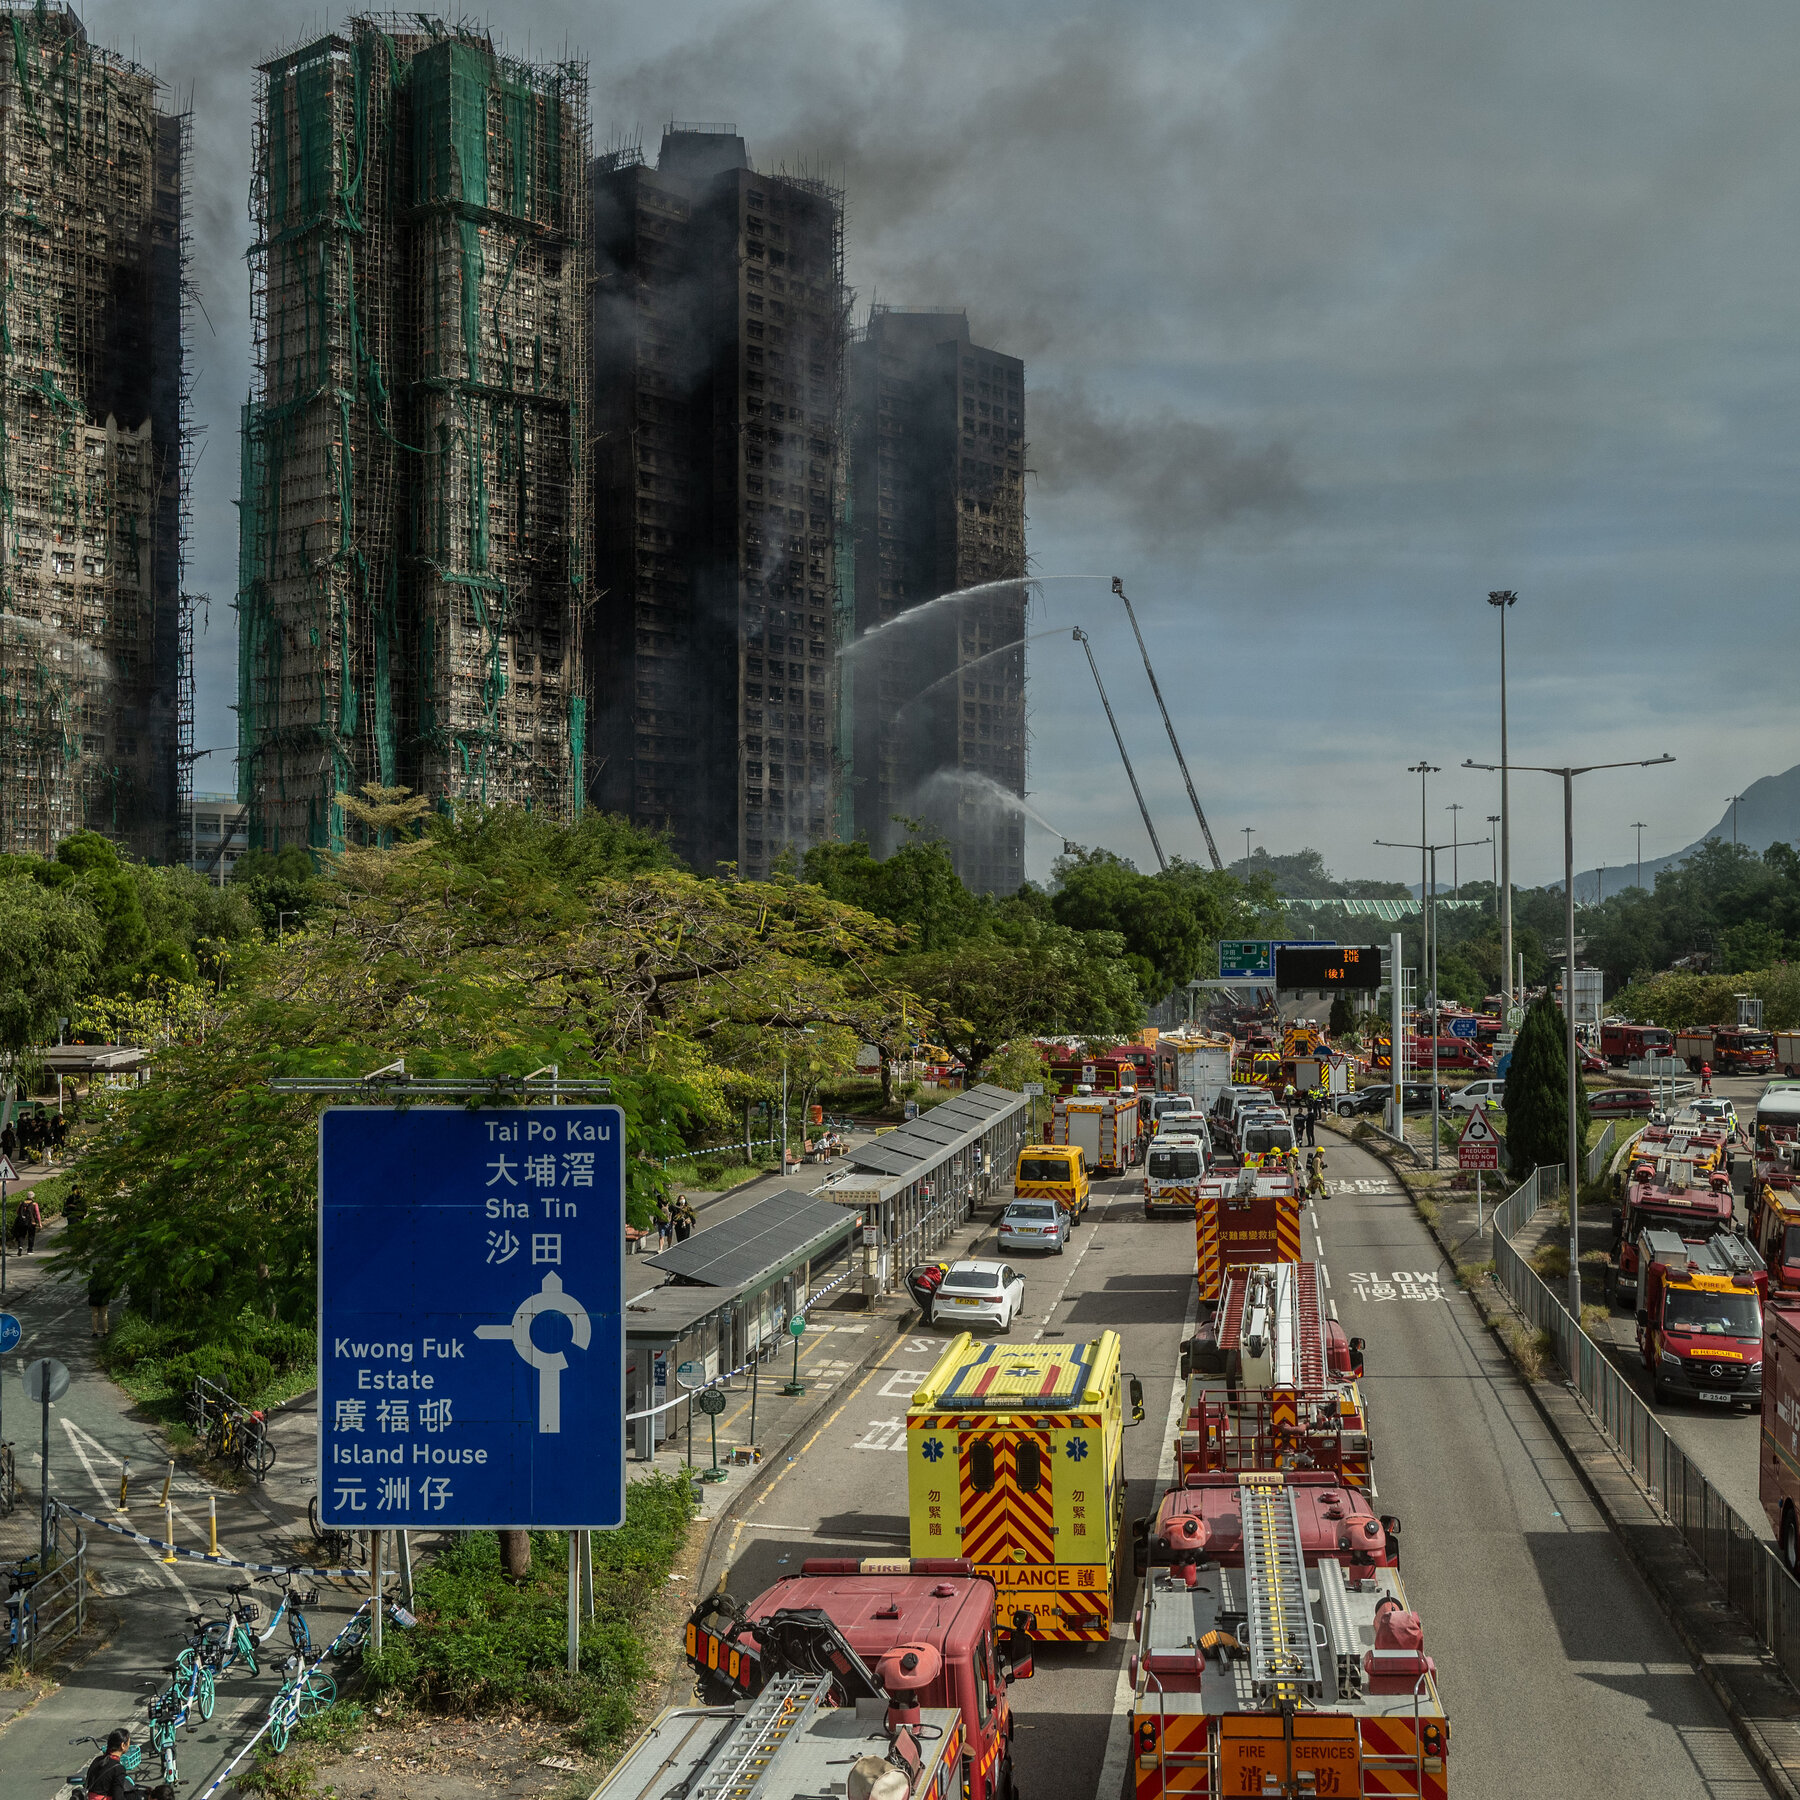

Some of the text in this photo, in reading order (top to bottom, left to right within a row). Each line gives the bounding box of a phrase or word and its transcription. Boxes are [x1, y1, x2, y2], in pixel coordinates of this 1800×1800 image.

[484, 1120, 611, 1142] Tai Po Kau
[485, 1152, 595, 1187] 大埔滘
[485, 1197, 578, 1219] Sha Tin
[485, 1229, 562, 1265] 沙田
[1348, 1271, 1439, 1283] SLOW
[334, 1337, 465, 1363] Kwong Fuk
[357, 1369, 435, 1390] Estate
[333, 1397, 454, 1434] 廣福邨
[333, 1443, 488, 1465] Island House
[1245, 1475, 1277, 1483] FIRE
[333, 1476, 454, 1511] 元洲仔
[928, 1489, 942, 1536] 勿緊隨
[1072, 1489, 1086, 1537] 勿緊隨
[868, 1564, 902, 1573] FIRE
[1077, 1568, 1096, 1587] 護
[1238, 1745, 1355, 1760] FIRE SERVICES
